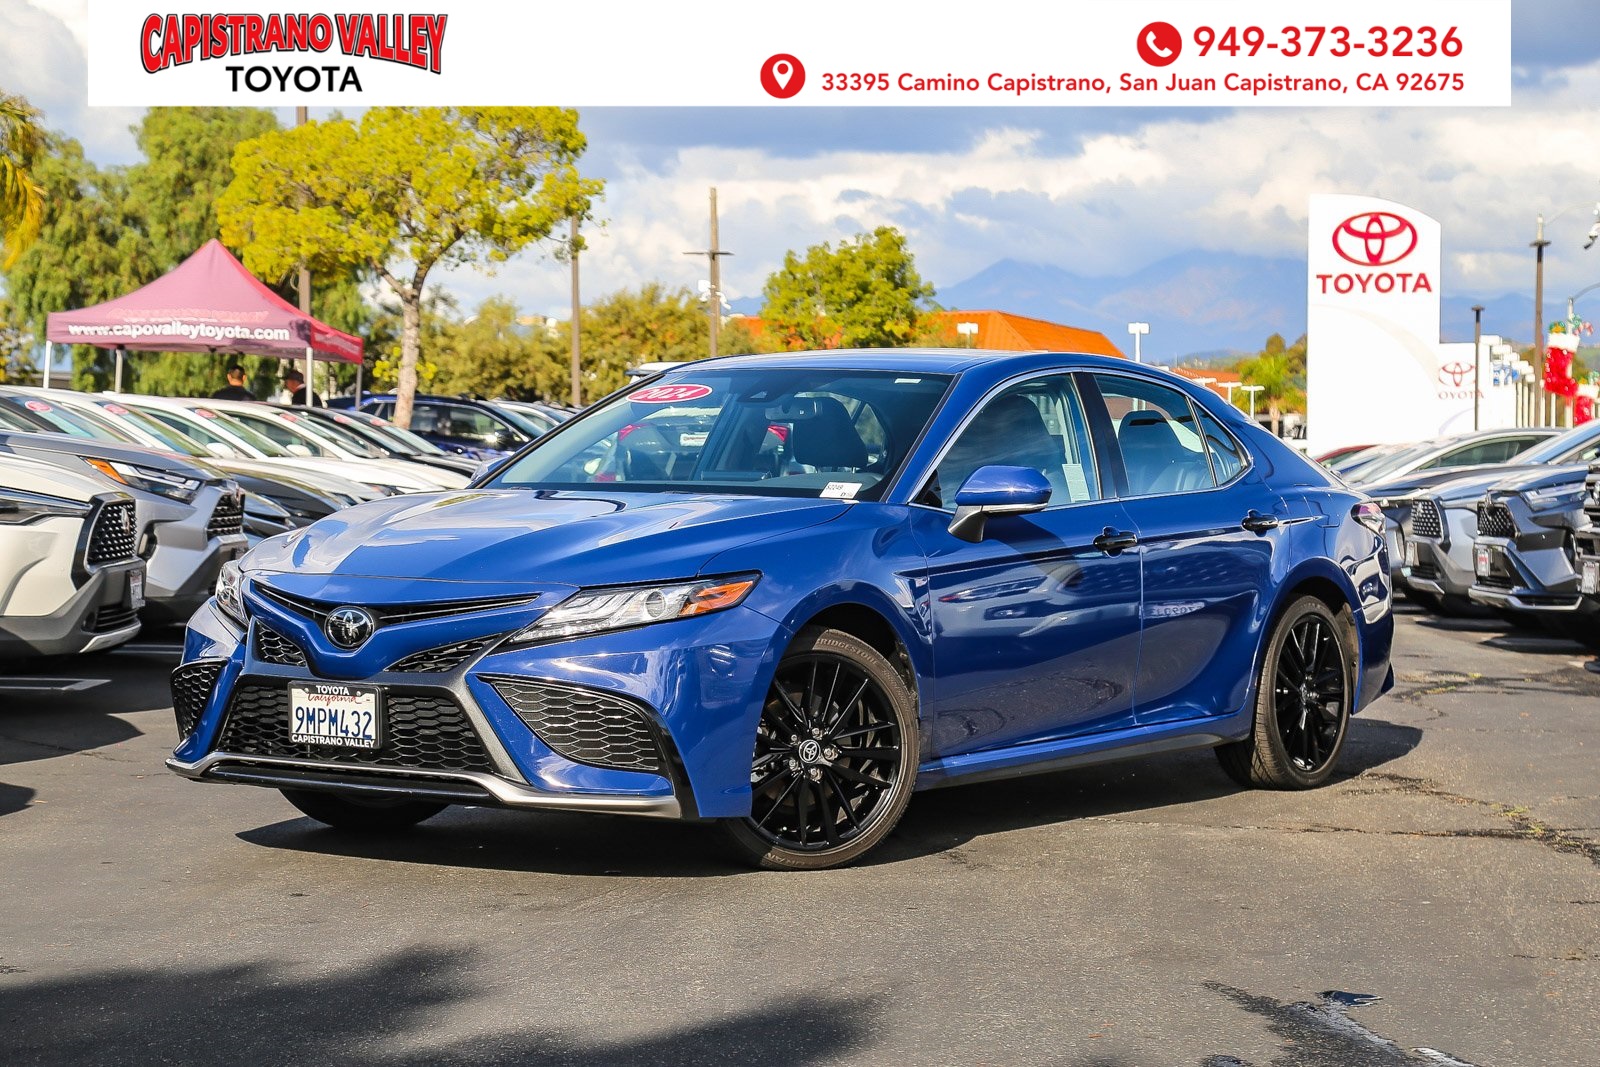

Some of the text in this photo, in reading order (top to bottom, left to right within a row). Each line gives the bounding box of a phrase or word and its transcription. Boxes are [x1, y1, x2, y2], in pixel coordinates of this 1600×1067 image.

[1316, 273, 1432, 294] TOYOTA
[68, 319, 290, 341] www.capovalleytoyota.com
[1438, 390, 1484, 400] OYOTA
[315, 685, 350, 695] TOYOTA
[295, 706, 372, 740] 9MPM432
[291, 734, 375, 748] CAPISTRANO VALLEY
